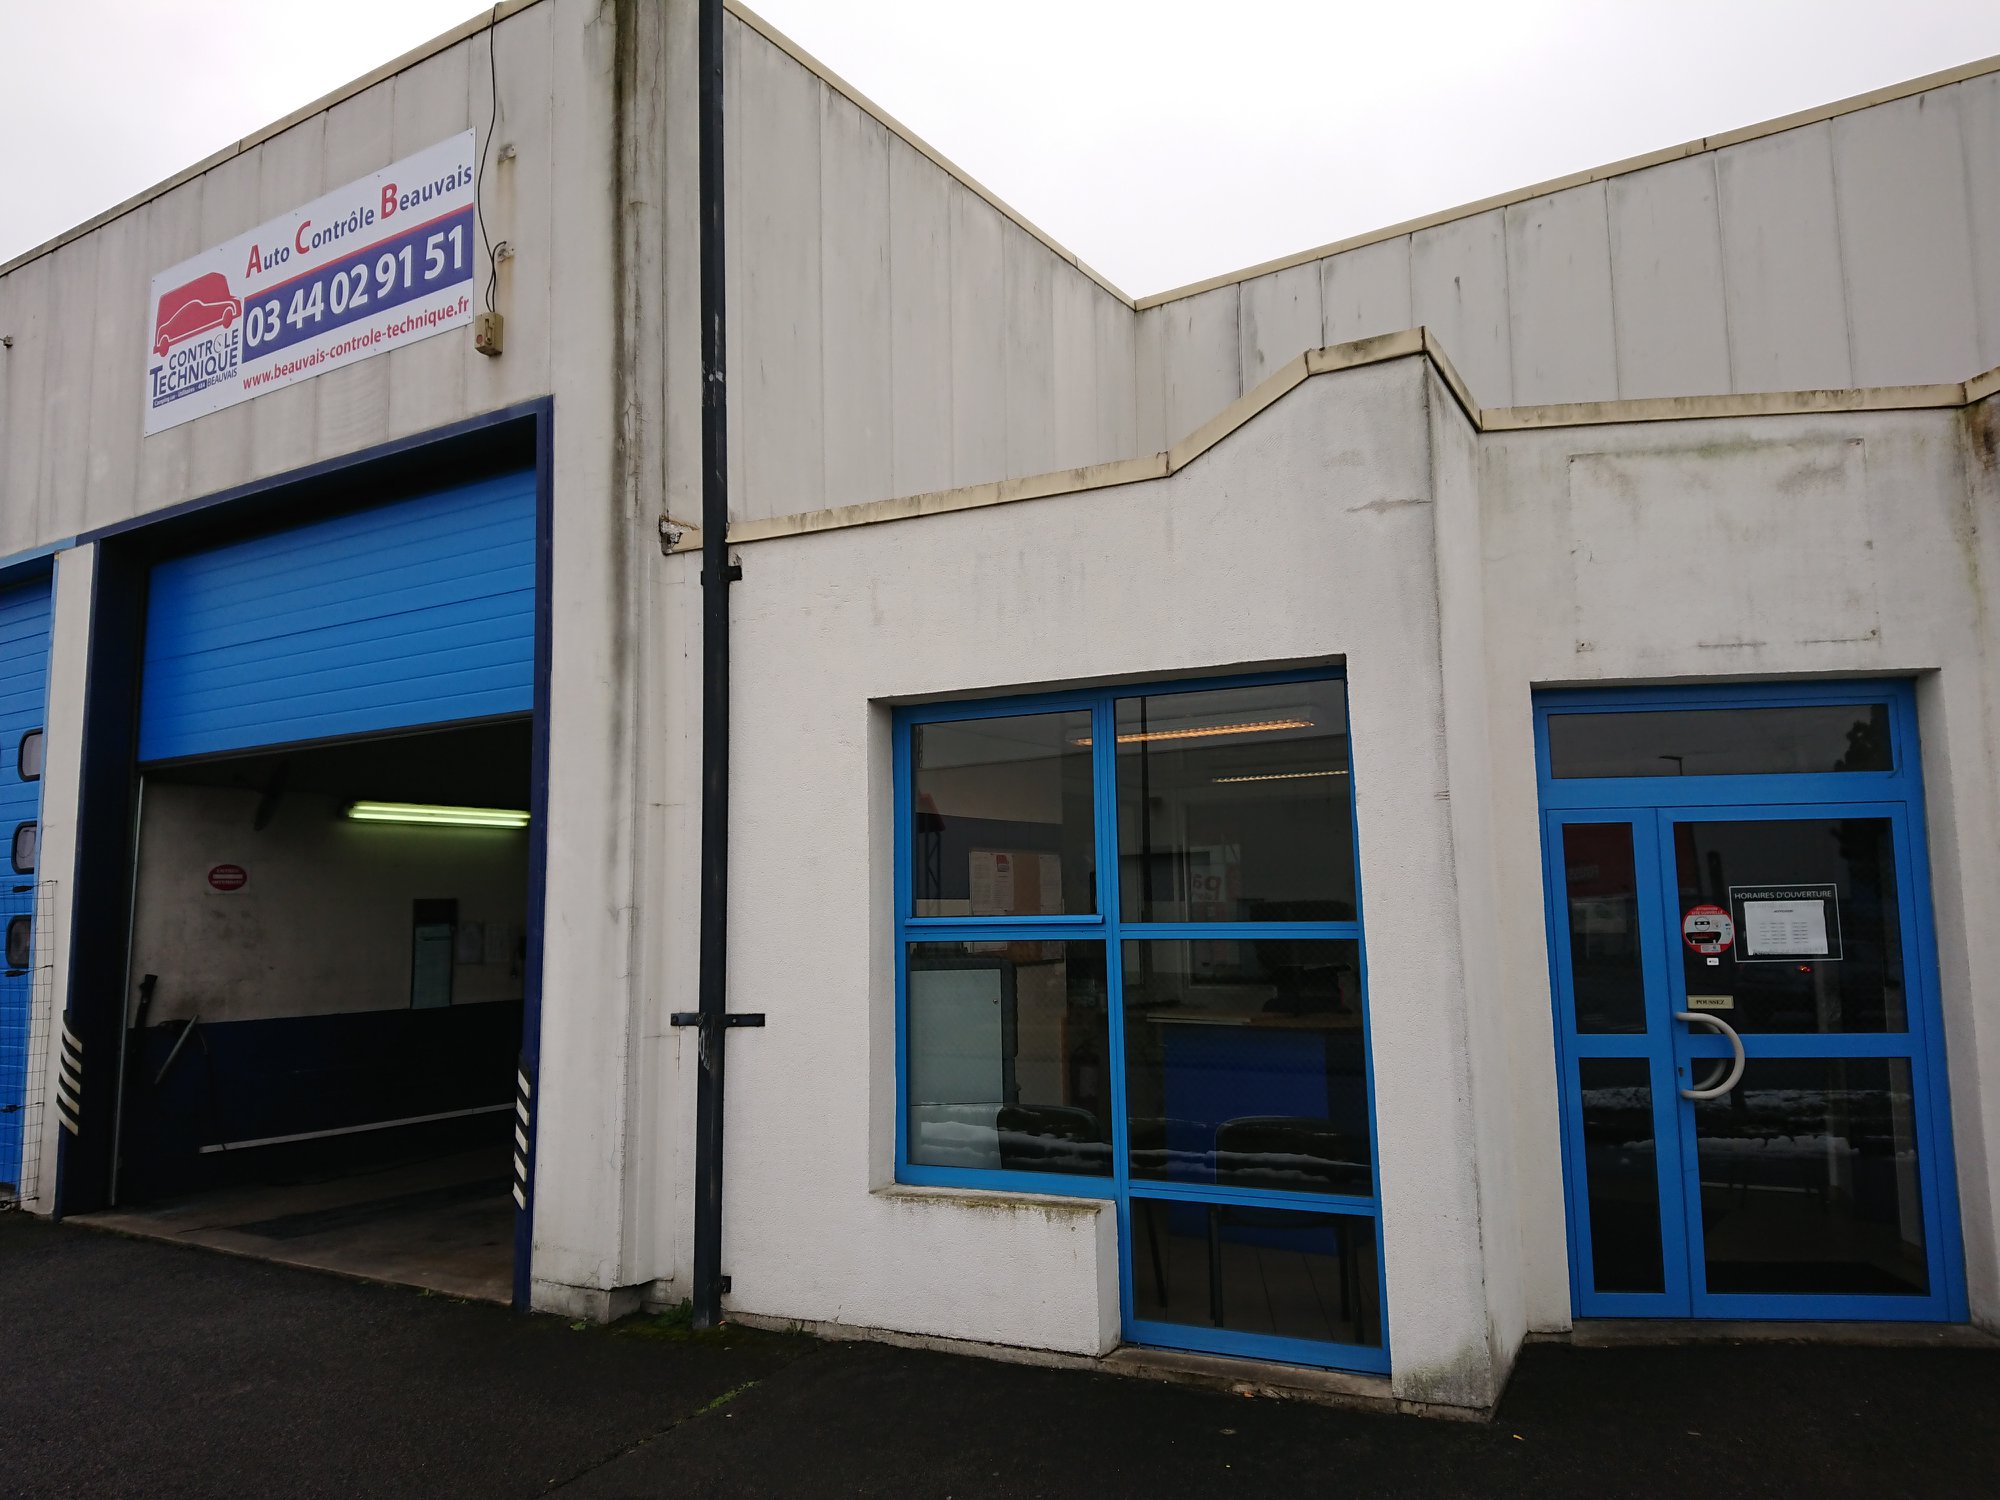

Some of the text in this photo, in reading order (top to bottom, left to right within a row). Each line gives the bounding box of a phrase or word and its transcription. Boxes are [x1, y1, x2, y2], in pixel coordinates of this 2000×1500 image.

[245, 164, 472, 279] Auto Contrôle Beauvais
[246, 224, 463, 347] 03 44 02 91 51
[149, 346, 238, 398] TECHNIQUE
[207, 367, 238, 387] BEAUVAIS
[242, 295, 469, 390] www.beauvais-controle-technique.fr
[1734, 889, 1832, 900] HORAIRES D'OUVERTURE
